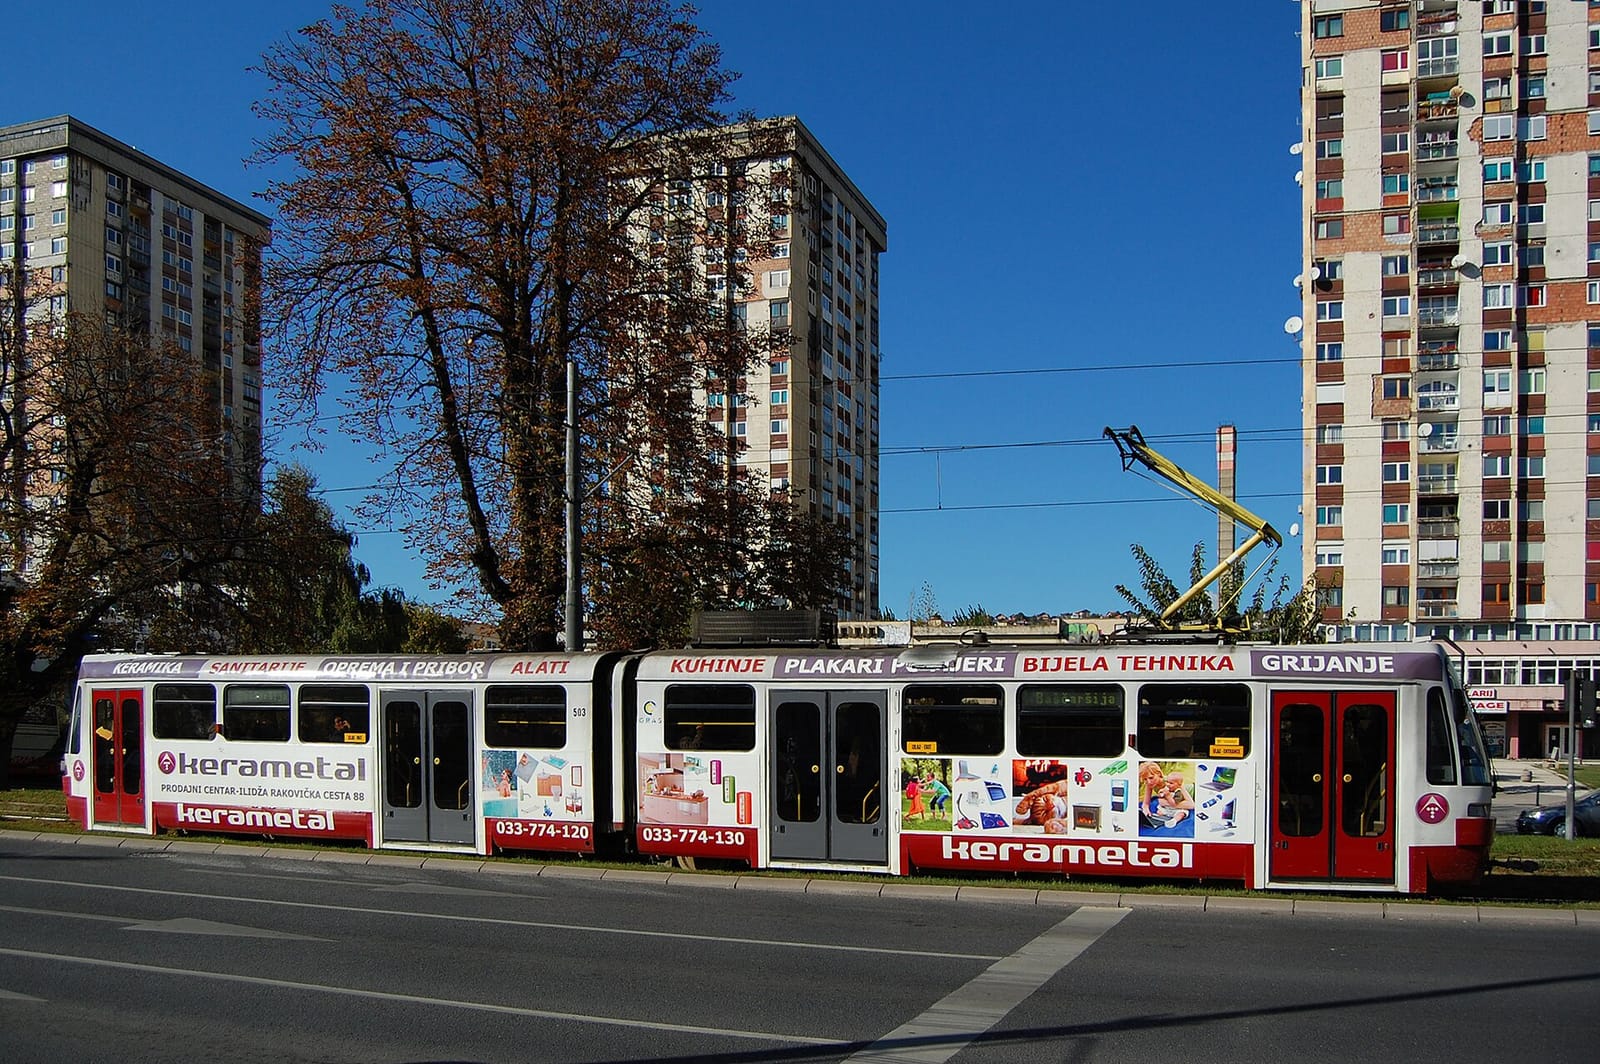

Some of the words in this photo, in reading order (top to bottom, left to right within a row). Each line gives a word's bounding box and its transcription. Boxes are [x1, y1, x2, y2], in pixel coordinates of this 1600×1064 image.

[112, 661, 183, 675] KERAMIKA
[323, 661, 395, 676] OPREMA
[400, 661, 410, 676] I
[413, 661, 485, 676] PRIBOR
[510, 660, 570, 675] ALATI
[670, 658, 766, 673] KUHINJE
[784, 658, 884, 674] PLAKARI
[1022, 655, 1109, 672] BIJELA
[1117, 655, 1235, 671] TEHNIKA
[1261, 655, 1395, 673] GRIJANJE
[573, 707, 586, 717] 503
[179, 752, 365, 781] kerametal
[161, 784, 202, 794] PRODAJNI
[204, 785, 269, 797] CENTAR-ILIDŽA
[271, 788, 321, 799] RAKOVIČKA
[323, 792, 351, 801] CESTA
[353, 793, 365, 801] 88
[176, 803, 335, 831] kerametal
[496, 821, 589, 839] 033-774-120
[642, 827, 745, 846] 033-774-130
[942, 836, 1194, 869] kerametal
